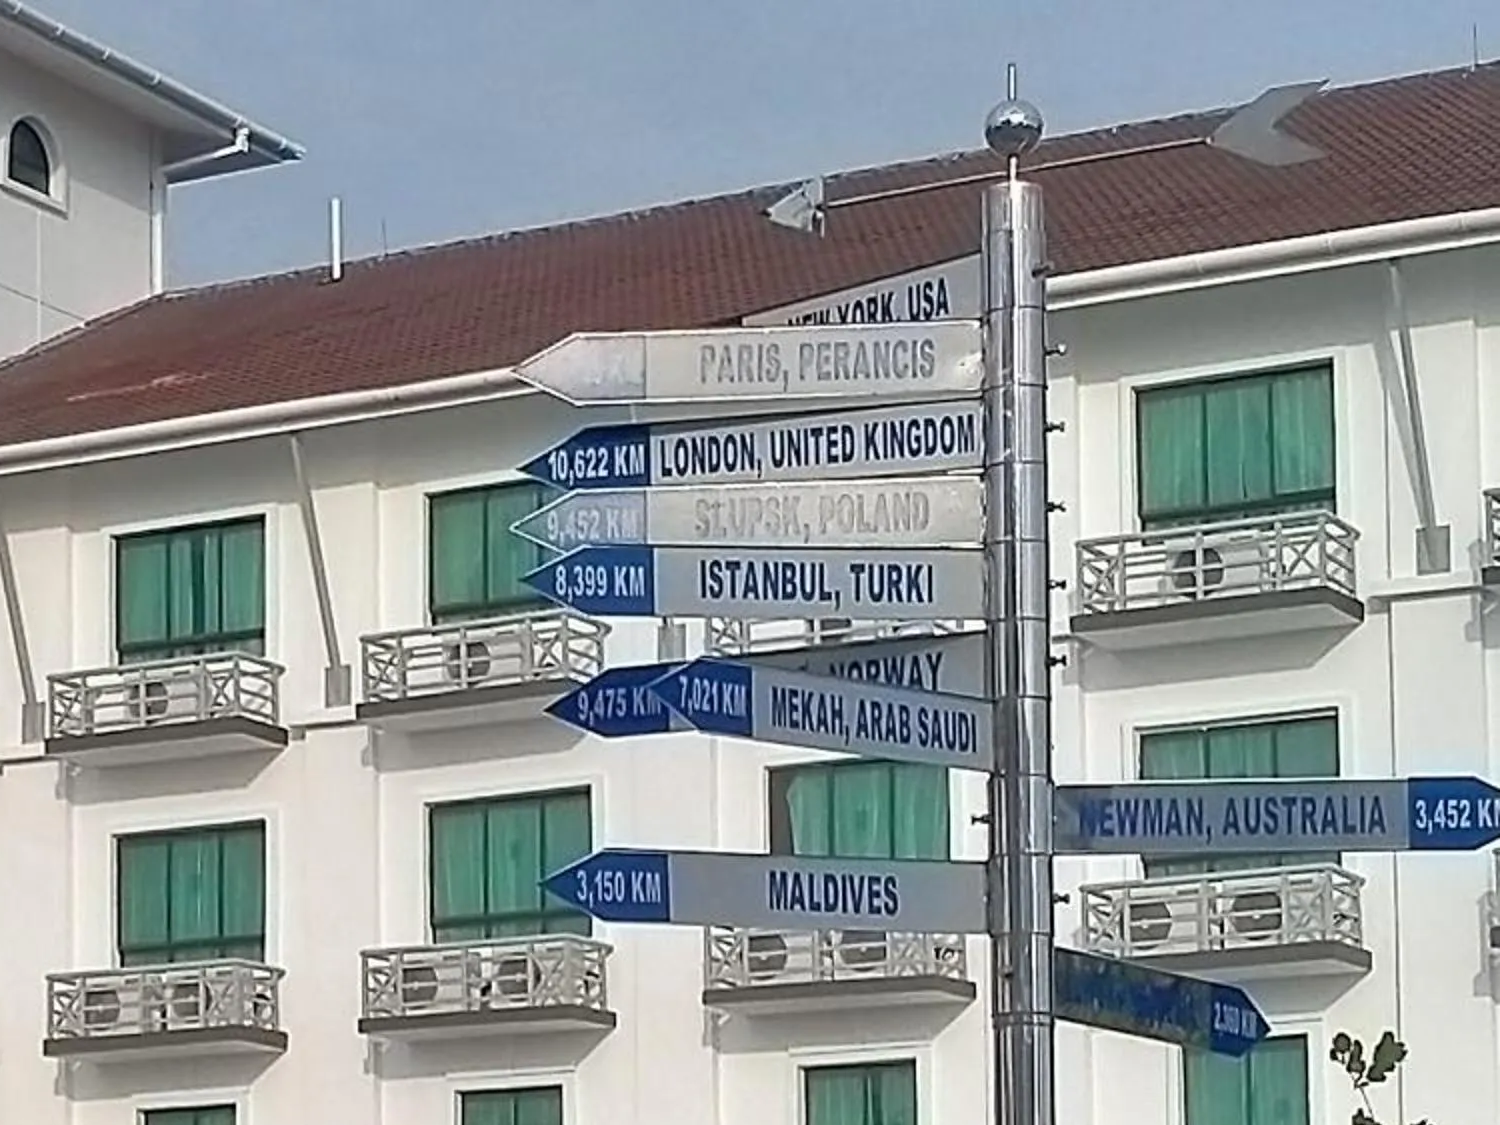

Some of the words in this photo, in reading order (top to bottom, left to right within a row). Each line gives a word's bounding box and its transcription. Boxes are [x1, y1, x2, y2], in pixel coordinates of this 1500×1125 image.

[908, 277, 950, 320] USA
[699, 341, 789, 392] PARIS,
[799, 338, 936, 382] PERANCIS
[547, 446, 609, 487] 10,622
[614, 442, 645, 477] KM
[660, 430, 763, 478] LONDON,
[770, 421, 855, 469] UNITED
[863, 413, 976, 461] KINGDOM
[606, 508, 639, 539] KM
[818, 491, 930, 535] POLAND
[554, 566, 607, 606] 8,399
[613, 566, 646, 598] KM
[700, 559, 841, 608] ISTANBUL,
[850, 562, 934, 603] TURKI
[577, 687, 627, 727] 9,475
[829, 652, 944, 692] ORWAY
[678, 675, 719, 715] 7,021
[722, 681, 747, 717] KM
[771, 686, 849, 746] MEKAH,
[855, 698, 911, 744] ARAB
[917, 706, 977, 753] SAUDI
[1078, 797, 1213, 844] NEWMAN,
[1222, 795, 1387, 838] AUSTRALIA
[1414, 799, 1471, 834] 3,452
[576, 869, 625, 908] 3,150
[631, 871, 662, 904] KM
[768, 870, 899, 918] MALDIVES
